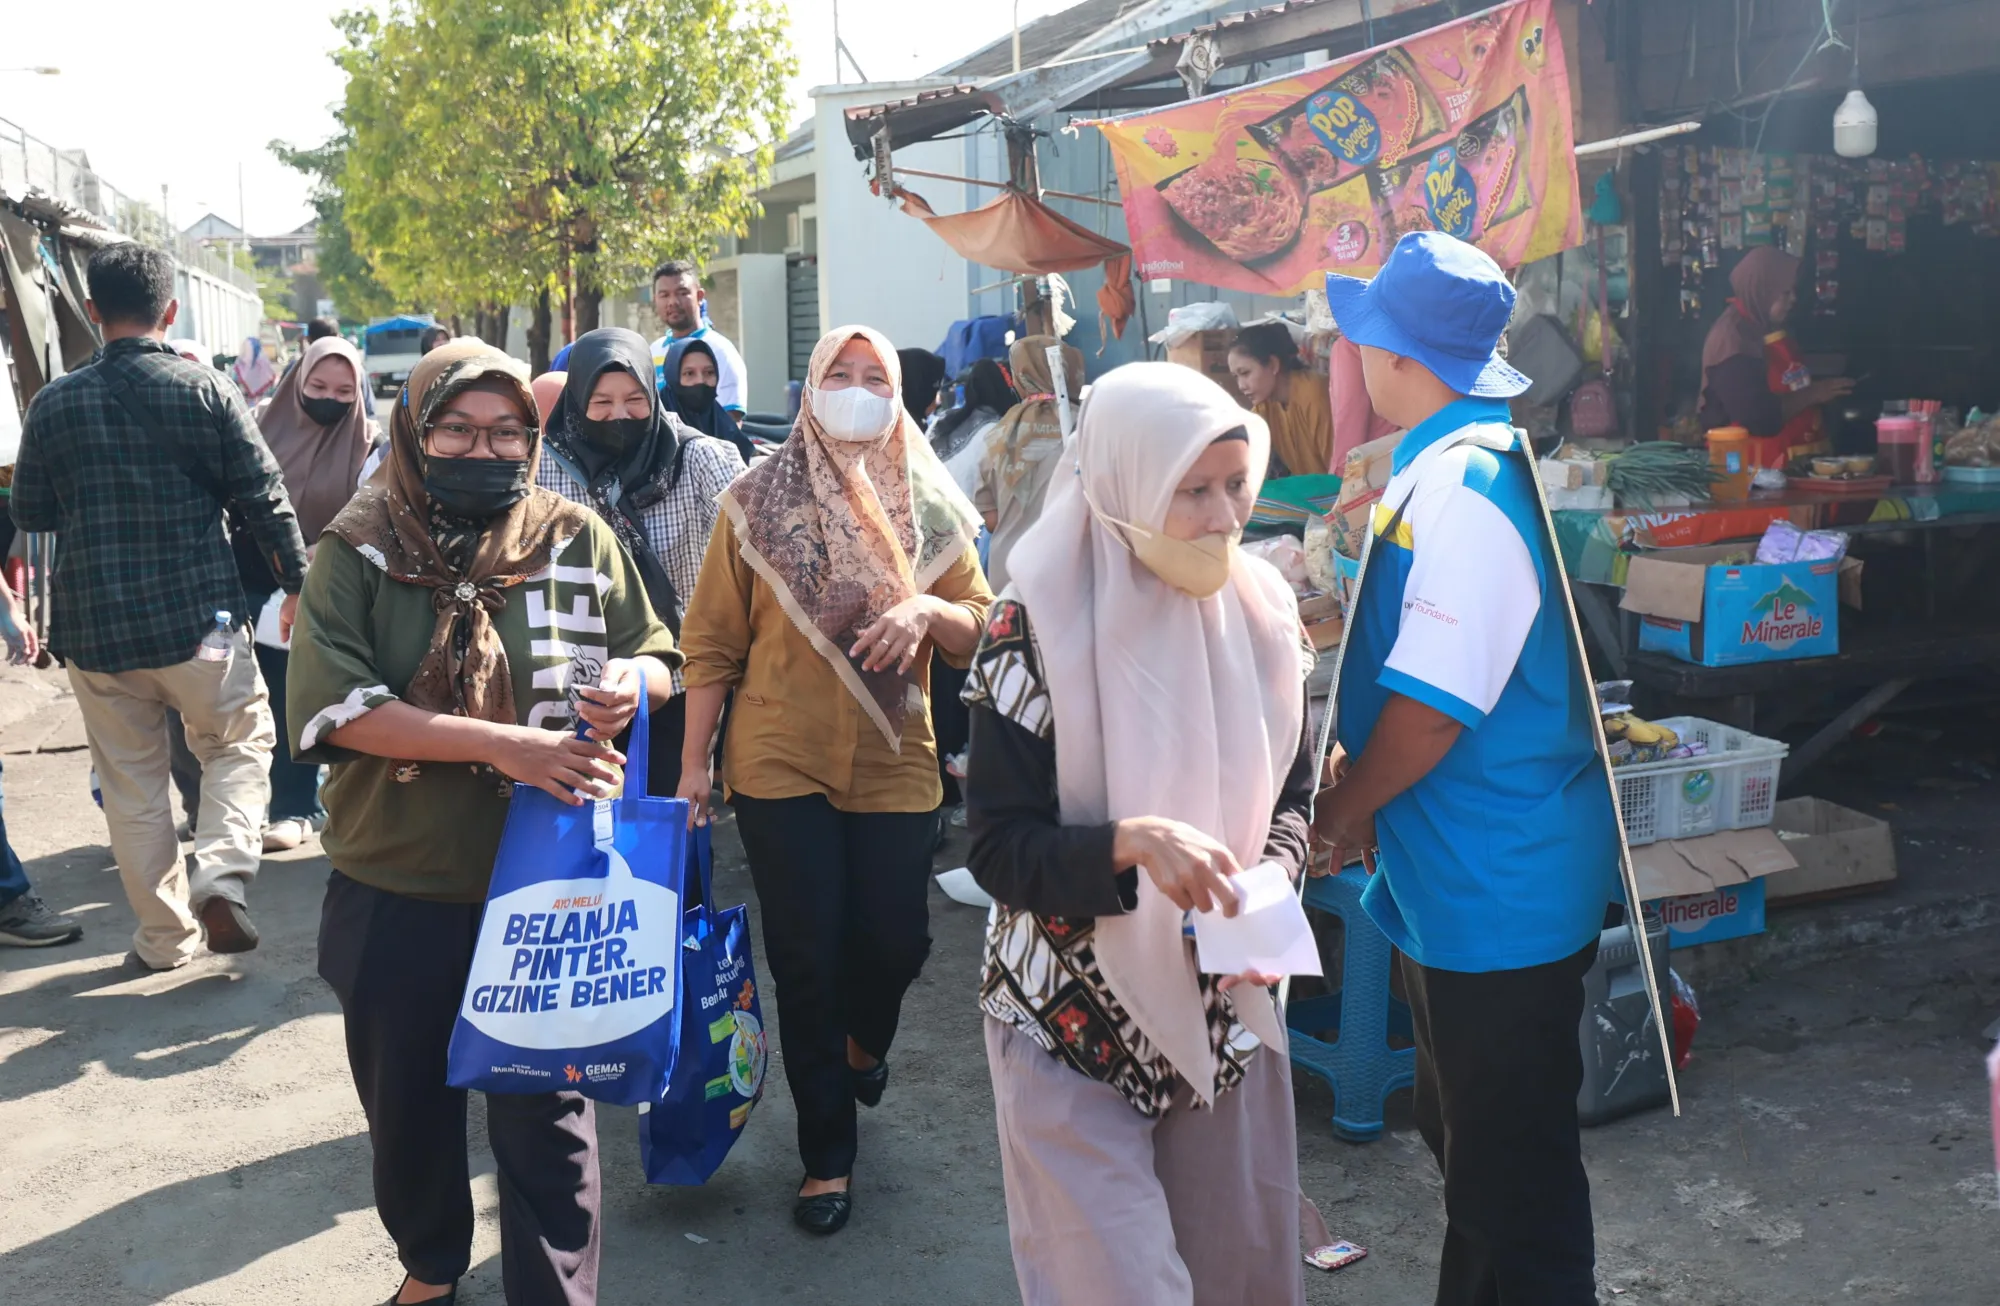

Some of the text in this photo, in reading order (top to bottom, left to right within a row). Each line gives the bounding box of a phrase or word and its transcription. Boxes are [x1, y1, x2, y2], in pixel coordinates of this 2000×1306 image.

[1311, 97, 1358, 140] POP
[1337, 117, 1375, 158] Spageti
[1338, 224, 1350, 243] 3
[1414, 602, 1459, 626] foundation
[1774, 597, 1796, 622] Le
[1741, 615, 1823, 645] Minerale
[502, 899, 639, 946] BELANJA
[509, 937, 636, 981] PINTER.
[472, 966, 667, 1014] GIZINE BENER
[516, 1068, 551, 1078] foundation
[585, 1063, 626, 1076] GEMAS
